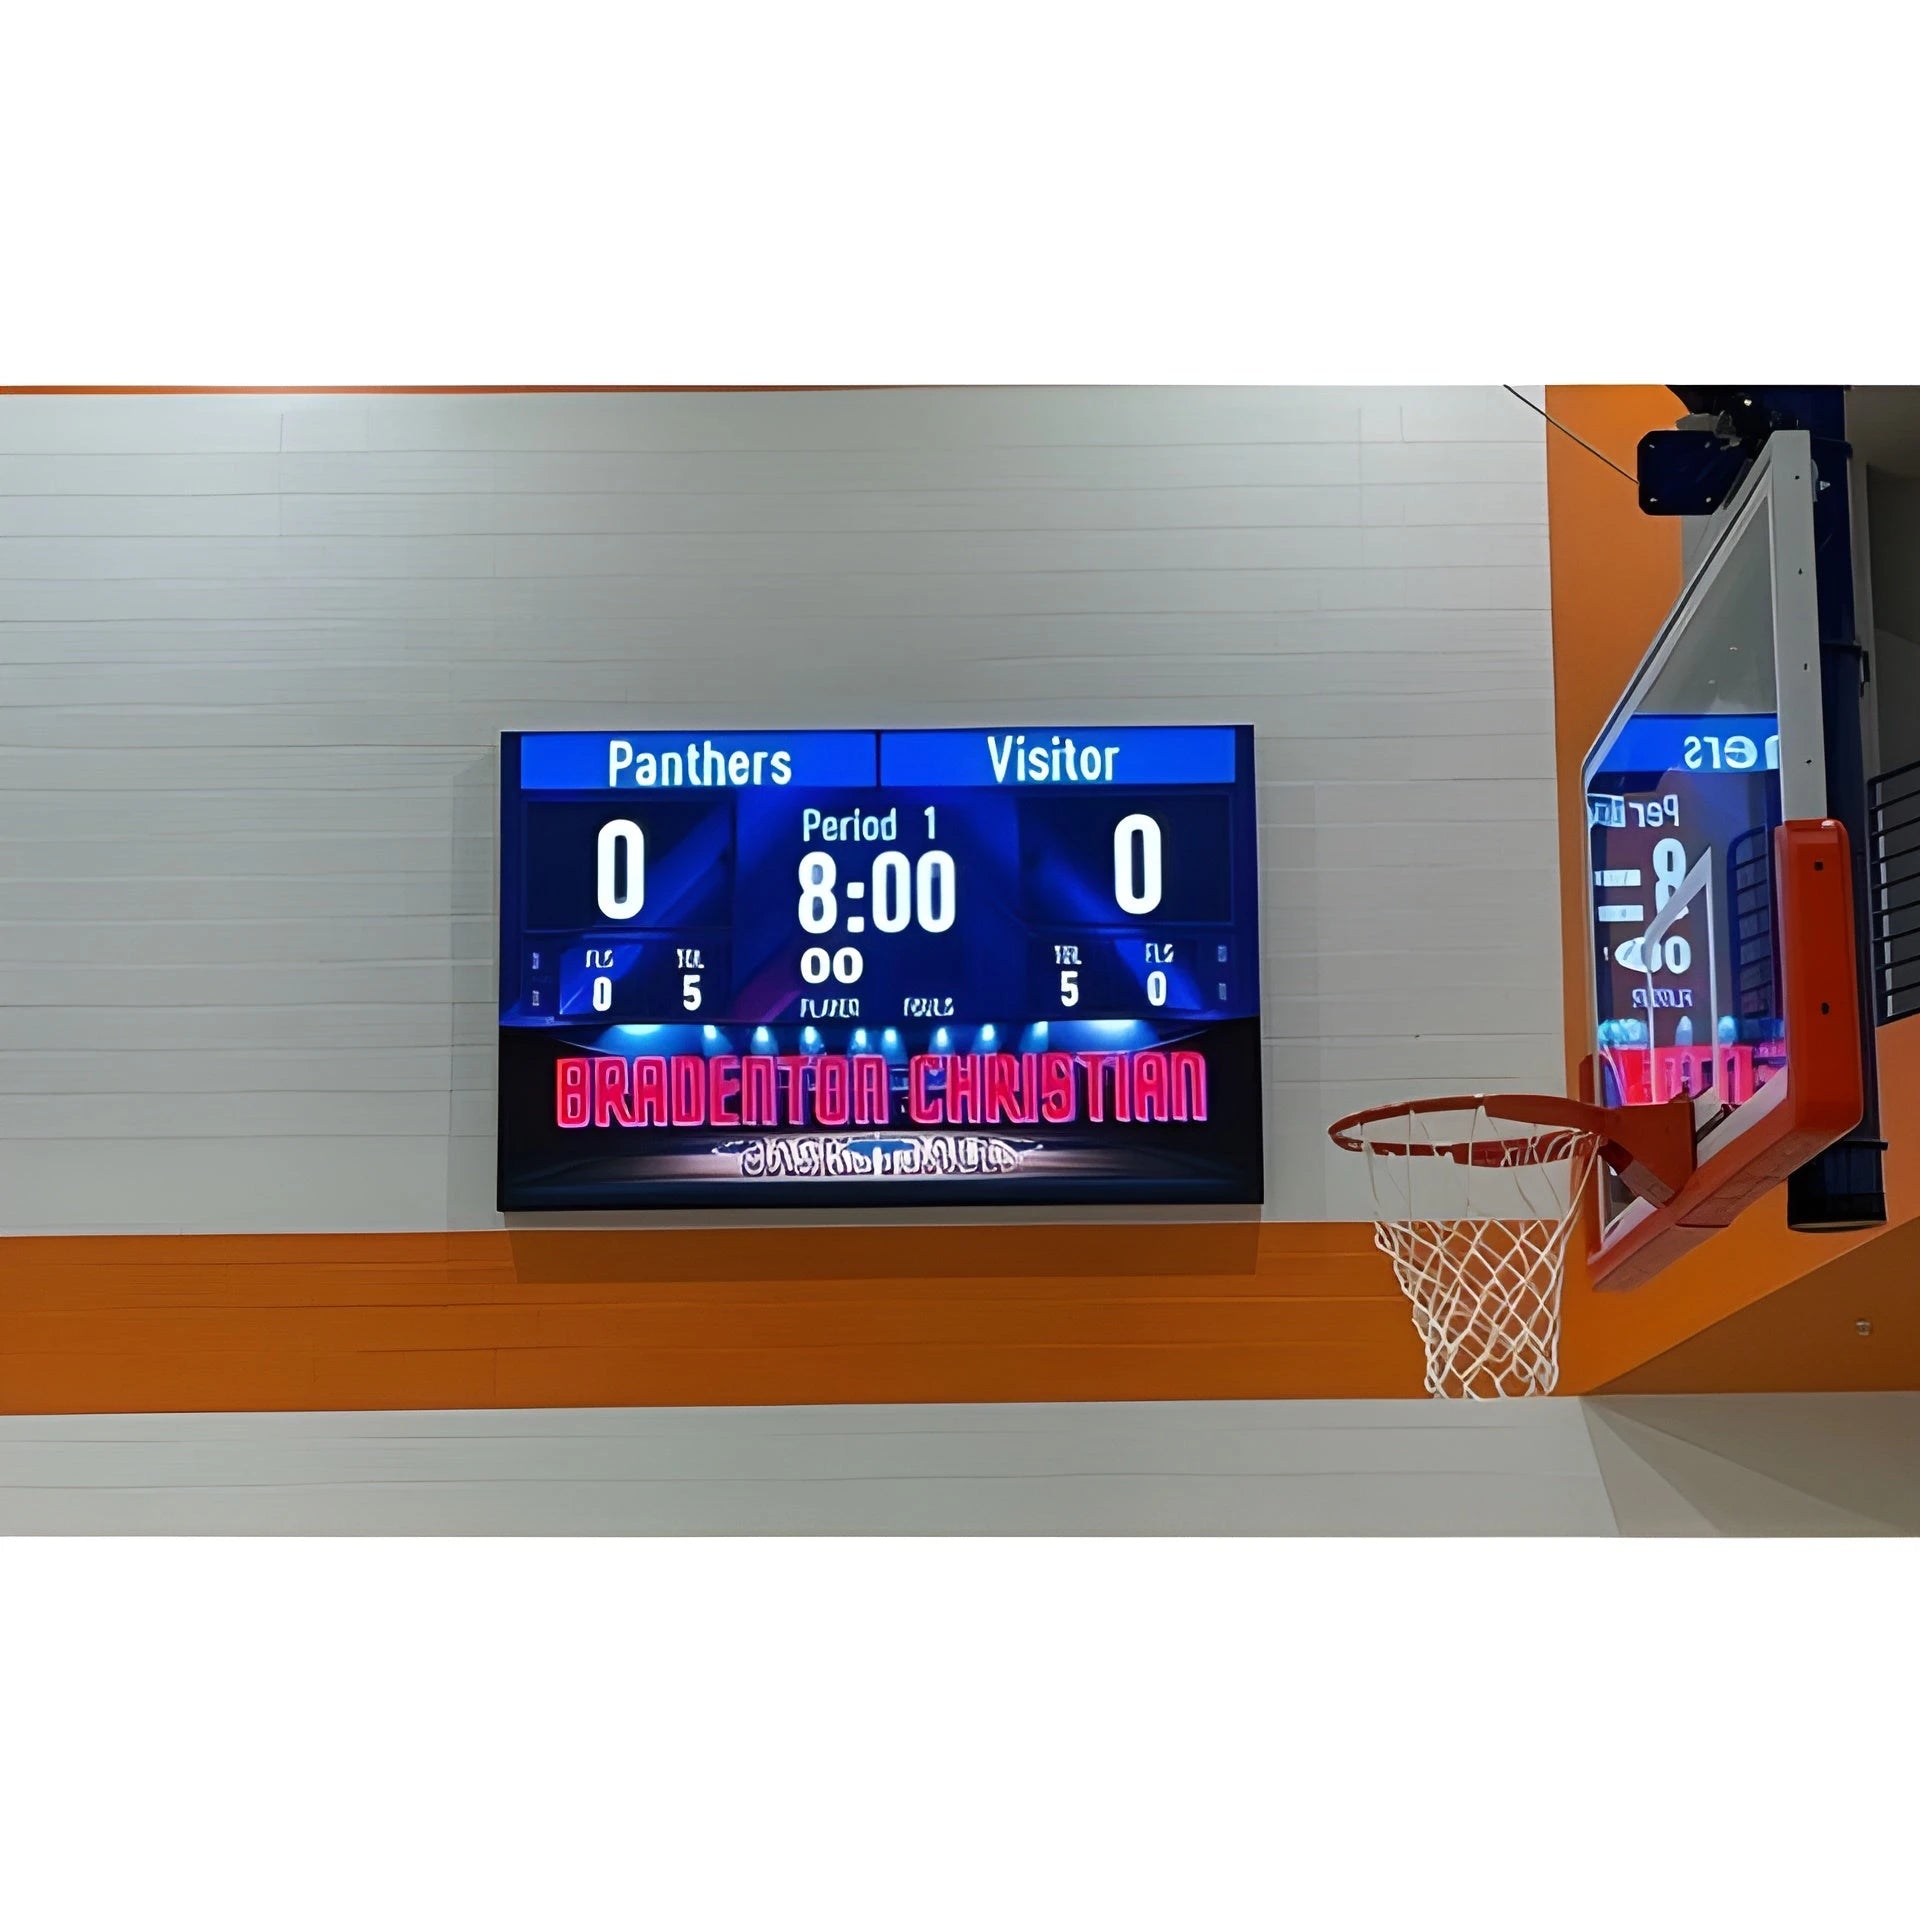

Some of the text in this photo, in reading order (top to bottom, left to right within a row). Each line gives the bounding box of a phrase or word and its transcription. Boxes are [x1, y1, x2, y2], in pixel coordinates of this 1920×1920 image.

[609, 740, 792, 787] Panthers
[987, 736, 1120, 782] Visitor
[803, 807, 936, 841] Period 1
[598, 819, 644, 919] 0
[1114, 814, 1161, 914] 0
[799, 851, 956, 934] 8:00
[800, 946, 863, 984] 00
[593, 976, 612, 1012] 0
[683, 974, 702, 1011] 5
[1060, 971, 1079, 1007] 5
[1147, 971, 1167, 1007] 0
[556, 1051, 1208, 1129] BRADENTON CHRISTIAN
